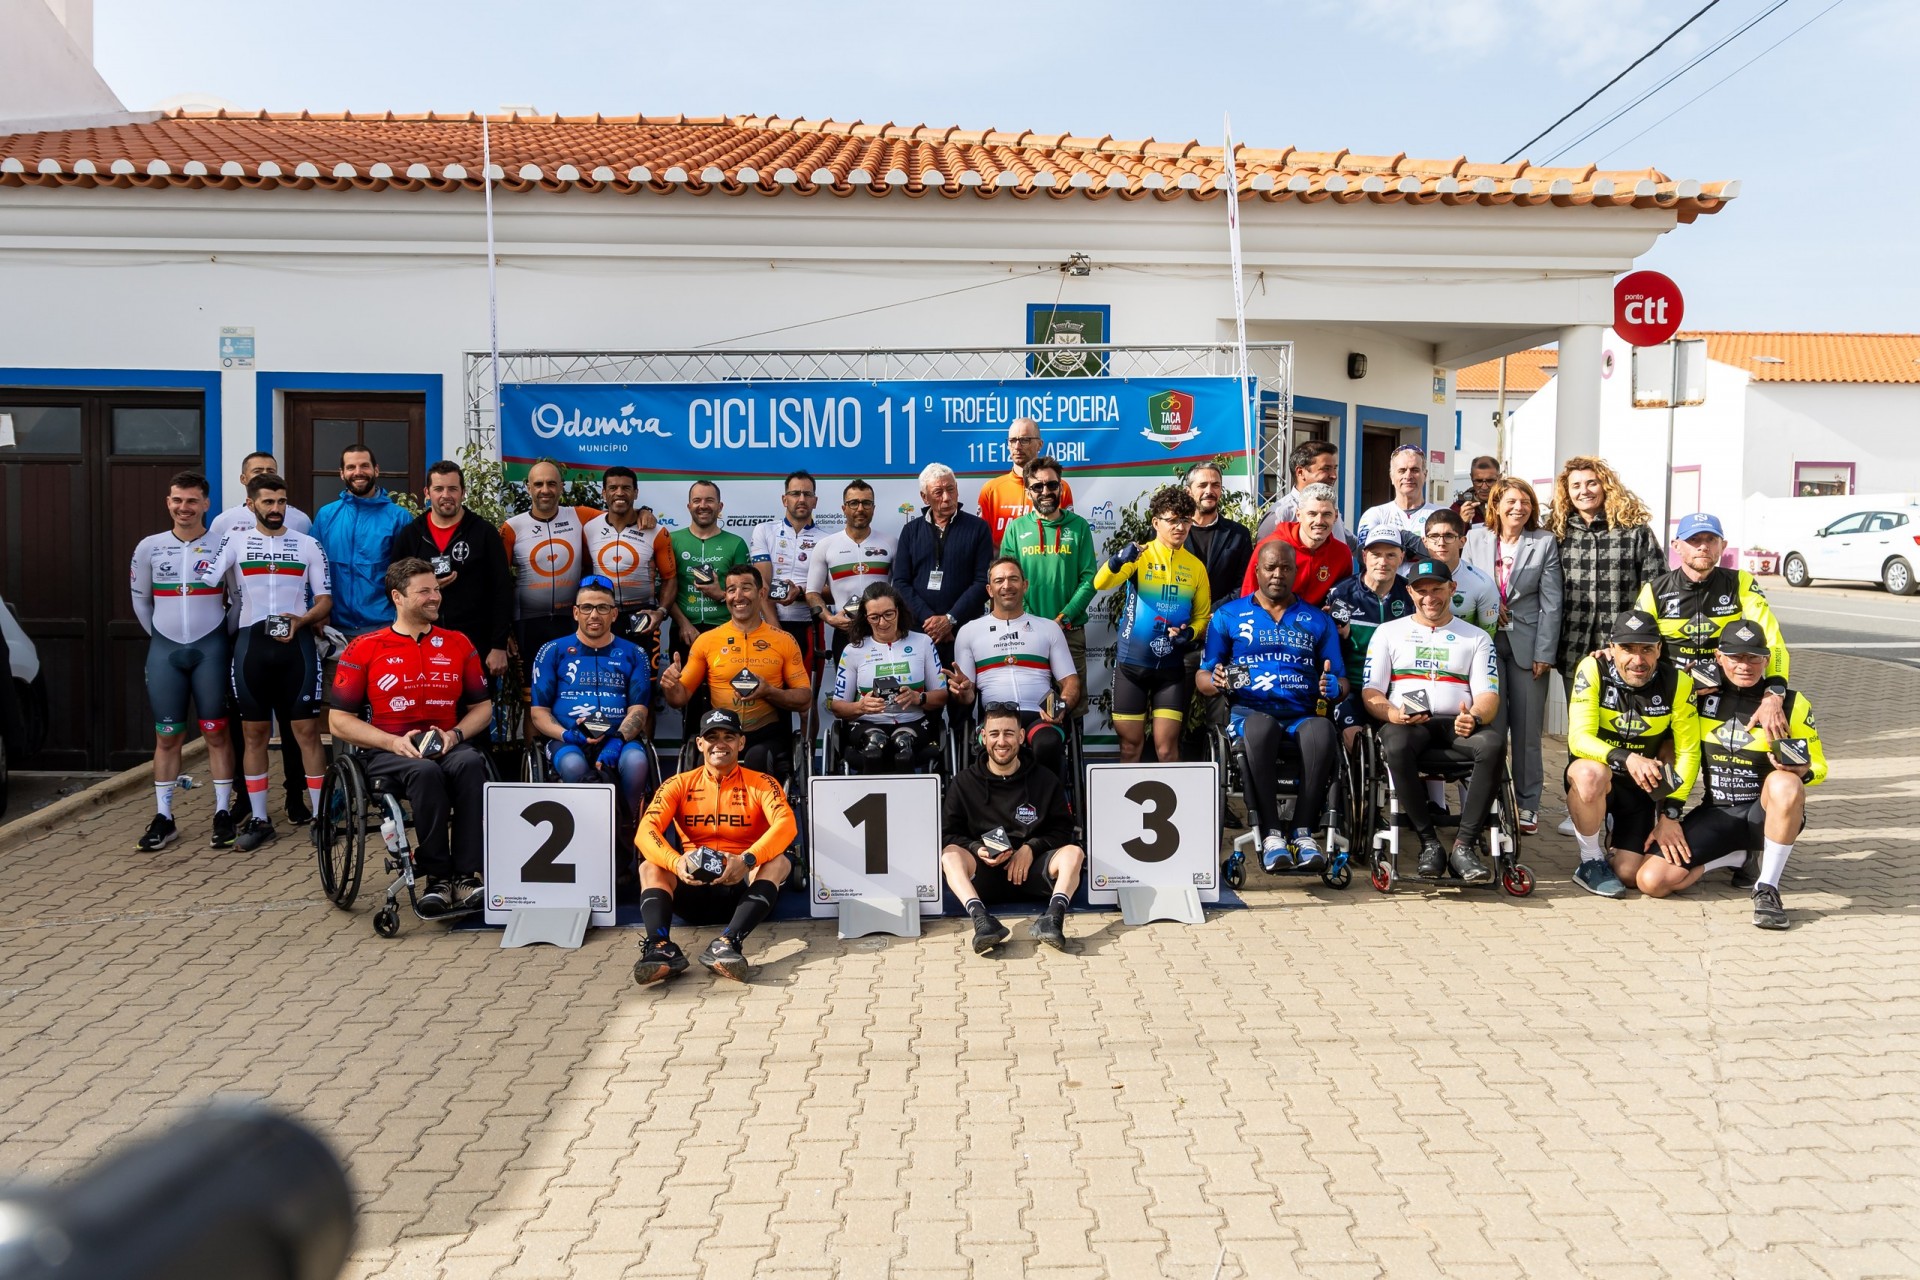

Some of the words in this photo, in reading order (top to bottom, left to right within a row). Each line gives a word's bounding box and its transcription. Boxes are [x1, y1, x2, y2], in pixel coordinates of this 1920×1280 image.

[1624, 296, 1668, 325] ctt
[941, 392, 1008, 423] TROFÉU
[1012, 391, 1054, 424] JOSÉ
[1057, 395, 1120, 422] POEIRA
[531, 402, 676, 439] Odemira
[688, 396, 862, 449] CICLISMO
[1161, 412, 1181, 425] TAÇA
[578, 443, 628, 452] MUNICÍPIO
[967, 443, 983, 463] 11
[988, 443, 998, 463] E
[1045, 442, 1090, 462] ABRIL
[247, 552, 299, 562] EFAPEL
[1021, 544, 1072, 557] PORTUGAL
[1121, 593, 1135, 640] Sarrabisco
[1683, 623, 1714, 634] OdL
[1259, 628, 1315, 643] DESCOBRE
[993, 640, 1026, 648] mirachoro
[1259, 636, 1314, 649] DESTREZA
[762, 657, 780, 665] Club
[930, 640, 943, 675] REN
[1238, 653, 1301, 665] CENTURY
[1487, 644, 1499, 677] REN
[1415, 660, 1439, 669] REN
[404, 672, 459, 683] LAZER
[579, 677, 625, 685] DESTREZA
[580, 671, 625, 680] DESCOBRE
[833, 666, 846, 699] REN
[1615, 720, 1645, 730] OdL
[1717, 728, 1748, 742] OdL
[1605, 739, 1622, 748] OdL
[1712, 754, 1728, 762] OdL
[1732, 756, 1753, 766] Team
[653, 775, 678, 806] EFAPEL
[760, 774, 782, 803] EFAPEL
[685, 814, 752, 827] EFAPEL
[1121, 780, 1181, 863] 3
[648, 829, 665, 849] EFAPEL
[843, 793, 889, 875] 1
[519, 800, 577, 884] 2
